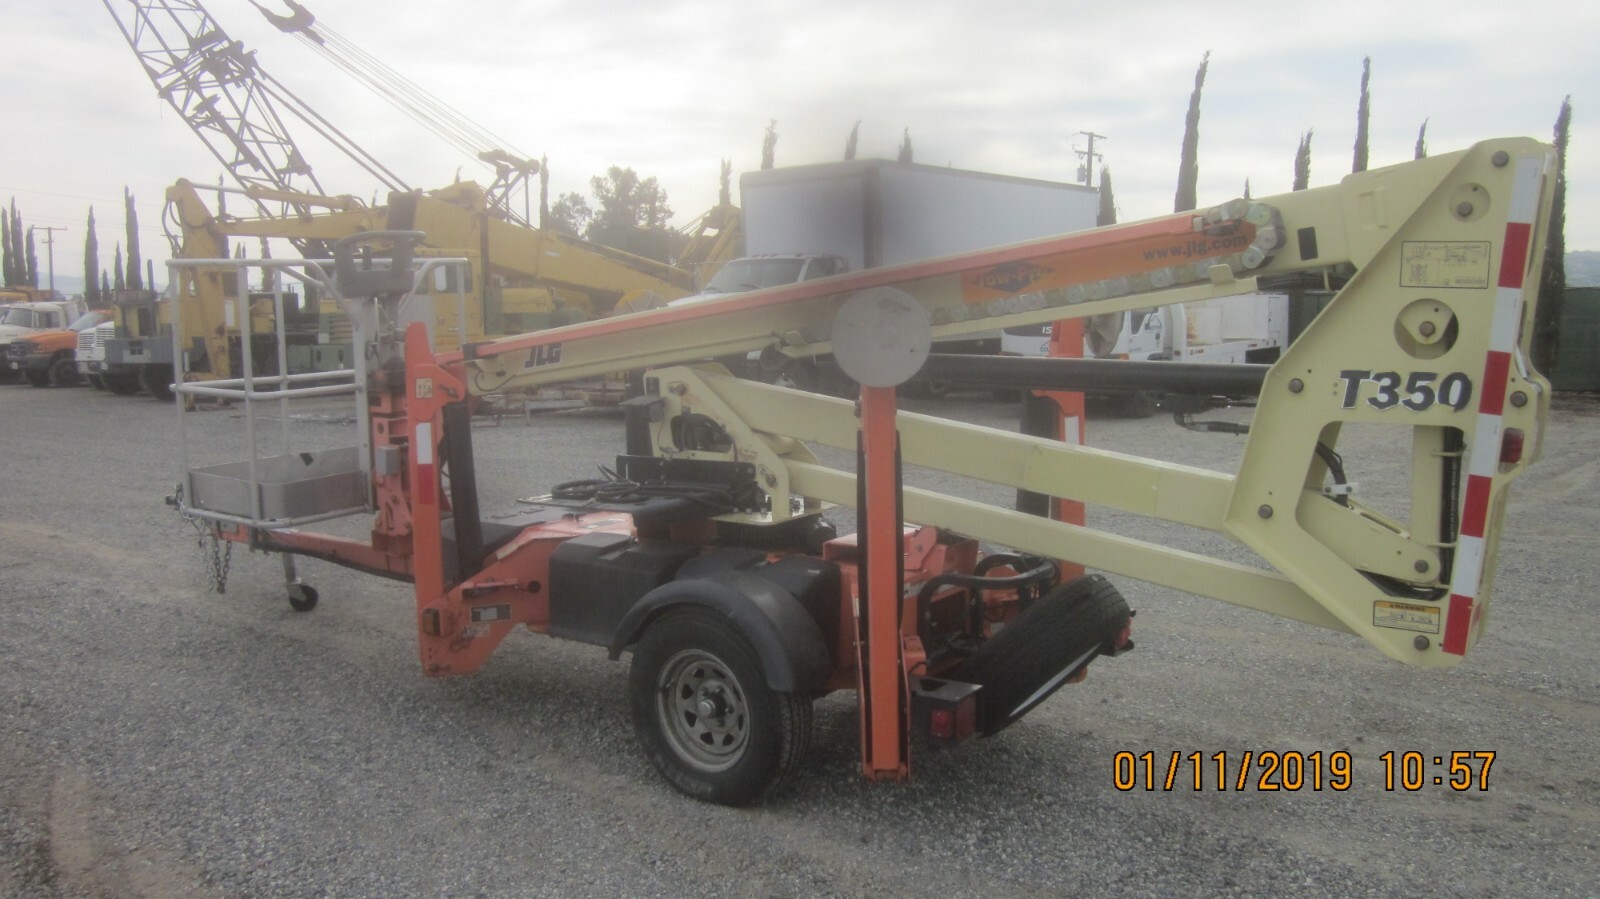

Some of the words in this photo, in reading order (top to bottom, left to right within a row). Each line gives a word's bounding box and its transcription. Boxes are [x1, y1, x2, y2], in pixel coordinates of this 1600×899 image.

[1143, 235, 1247, 261] www.jlg.com
[524, 342, 562, 368] JLG
[1340, 370, 1472, 412] T350
